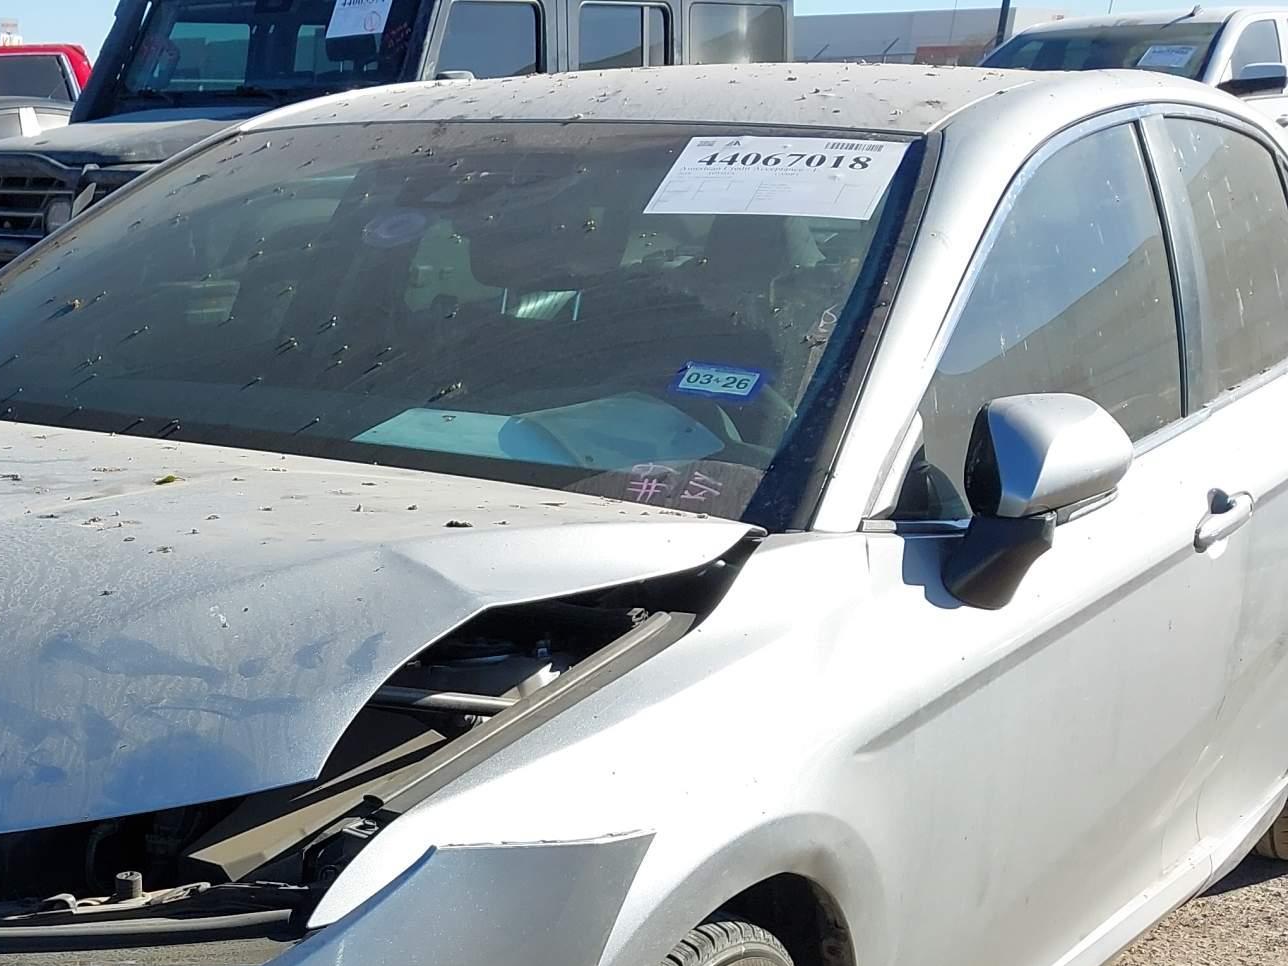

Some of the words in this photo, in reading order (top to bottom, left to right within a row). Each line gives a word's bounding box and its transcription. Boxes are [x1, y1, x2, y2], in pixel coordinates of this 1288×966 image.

[697, 151, 872, 170] 44067018
[686, 372, 714, 385] 03
[721, 376, 751, 390] 26
